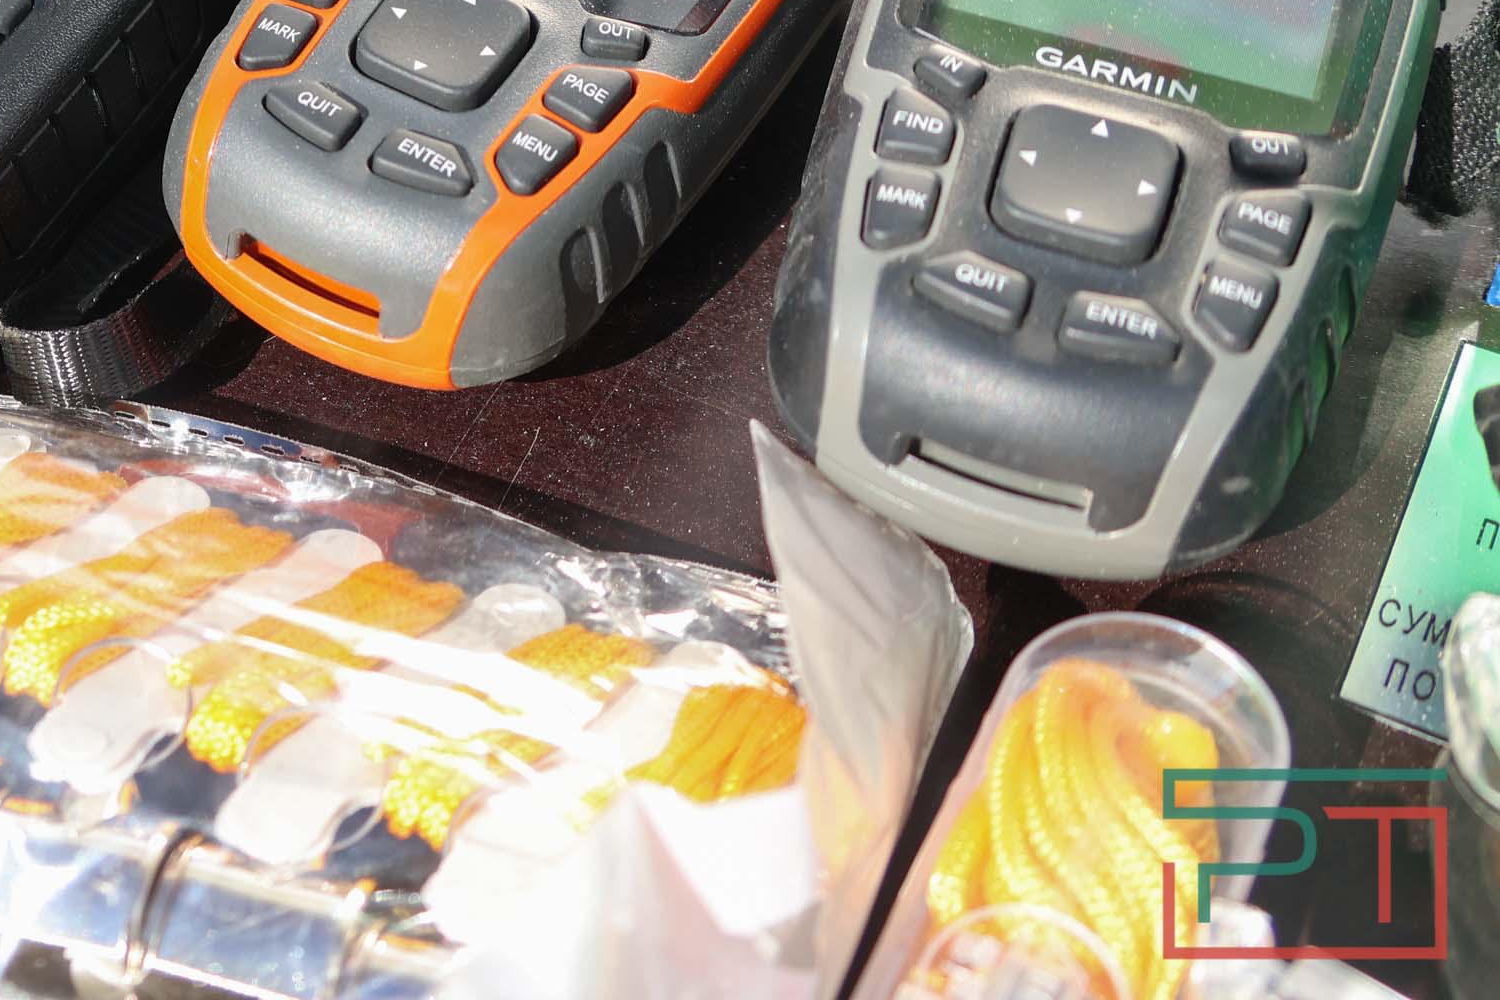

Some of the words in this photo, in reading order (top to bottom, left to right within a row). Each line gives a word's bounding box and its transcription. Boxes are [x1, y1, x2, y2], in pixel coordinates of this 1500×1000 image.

[258, 17, 301, 42] MARK
[598, 22, 635, 40] OUT
[939, 54, 964, 73] IN
[1035, 45, 1198, 103] GARMIN
[297, 90, 343, 118] QUIT
[563, 73, 610, 105] PAGE
[892, 110, 944, 135] FIND
[397, 138, 457, 178] ENTER
[512, 129, 559, 163] MENU
[1251, 137, 1291, 156] OUT
[876, 183, 928, 210] MARK
[1238, 202, 1293, 235] PAGE
[955, 263, 1009, 293] QUIT
[1209, 275, 1263, 310] MENU
[1086, 300, 1158, 339] ENTER
